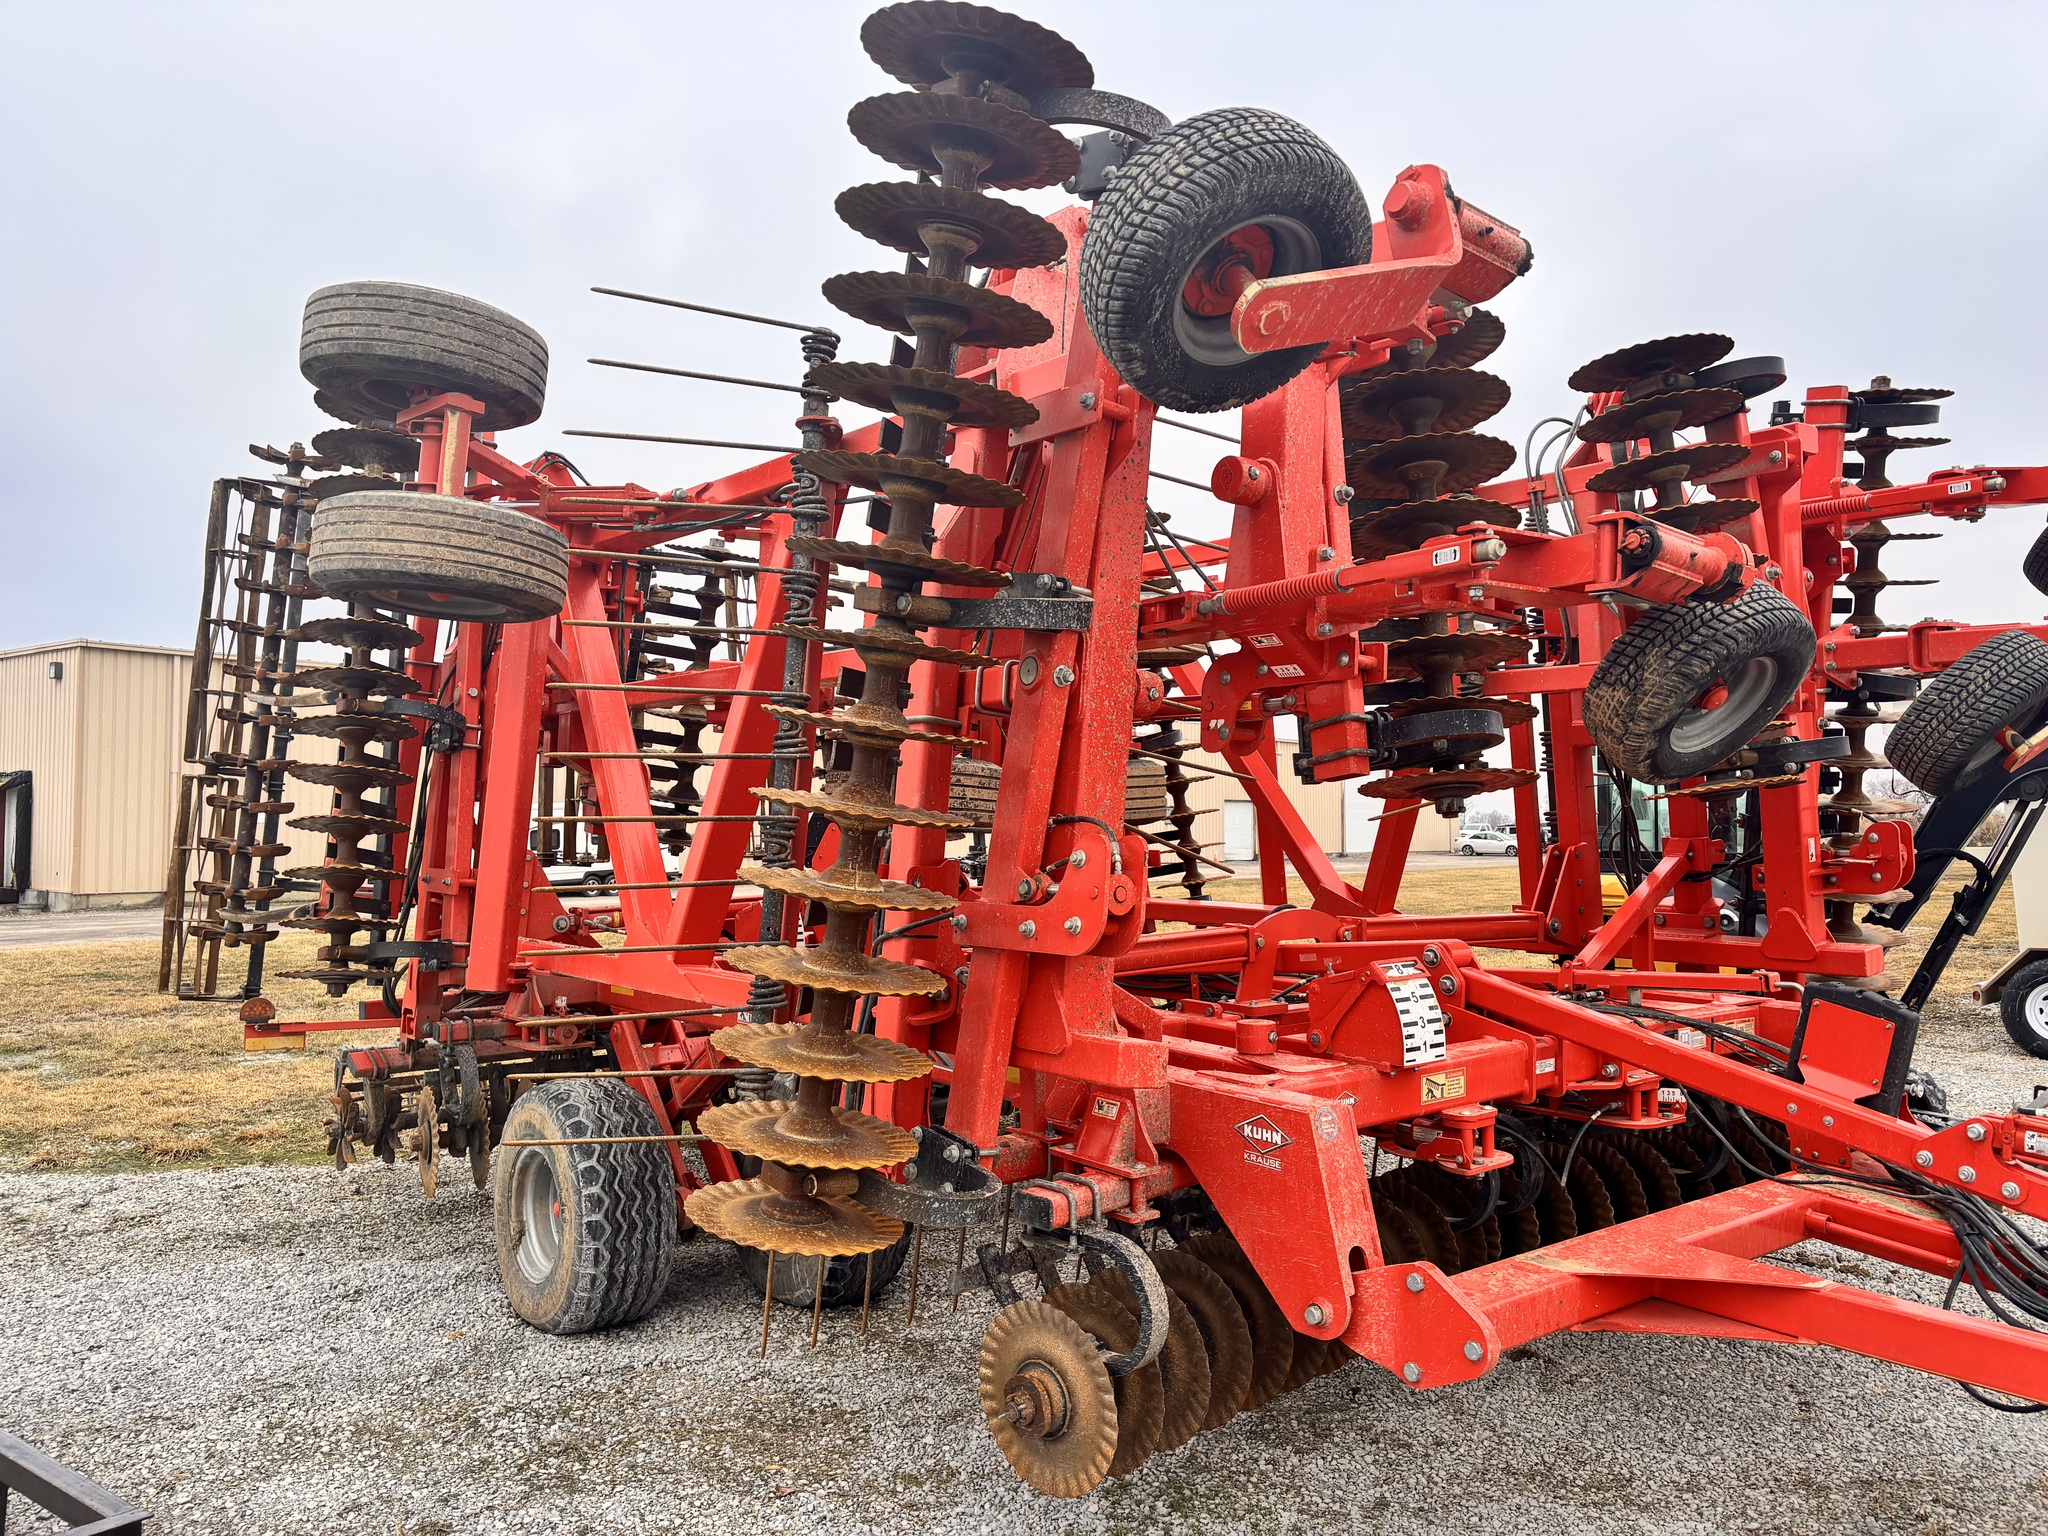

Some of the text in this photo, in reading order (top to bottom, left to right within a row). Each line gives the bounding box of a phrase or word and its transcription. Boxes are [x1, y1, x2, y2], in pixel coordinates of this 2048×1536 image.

[1394, 964, 1404, 975] 8
[1410, 991, 1419, 1004] 5
[1419, 1016, 1426, 1029] 3
[1422, 1040, 1428, 1053] 1
[1338, 1097, 1355, 1106] UHN
[1243, 1123, 1282, 1145] KUHN
[1243, 1152, 1282, 1170] KRAUSE
